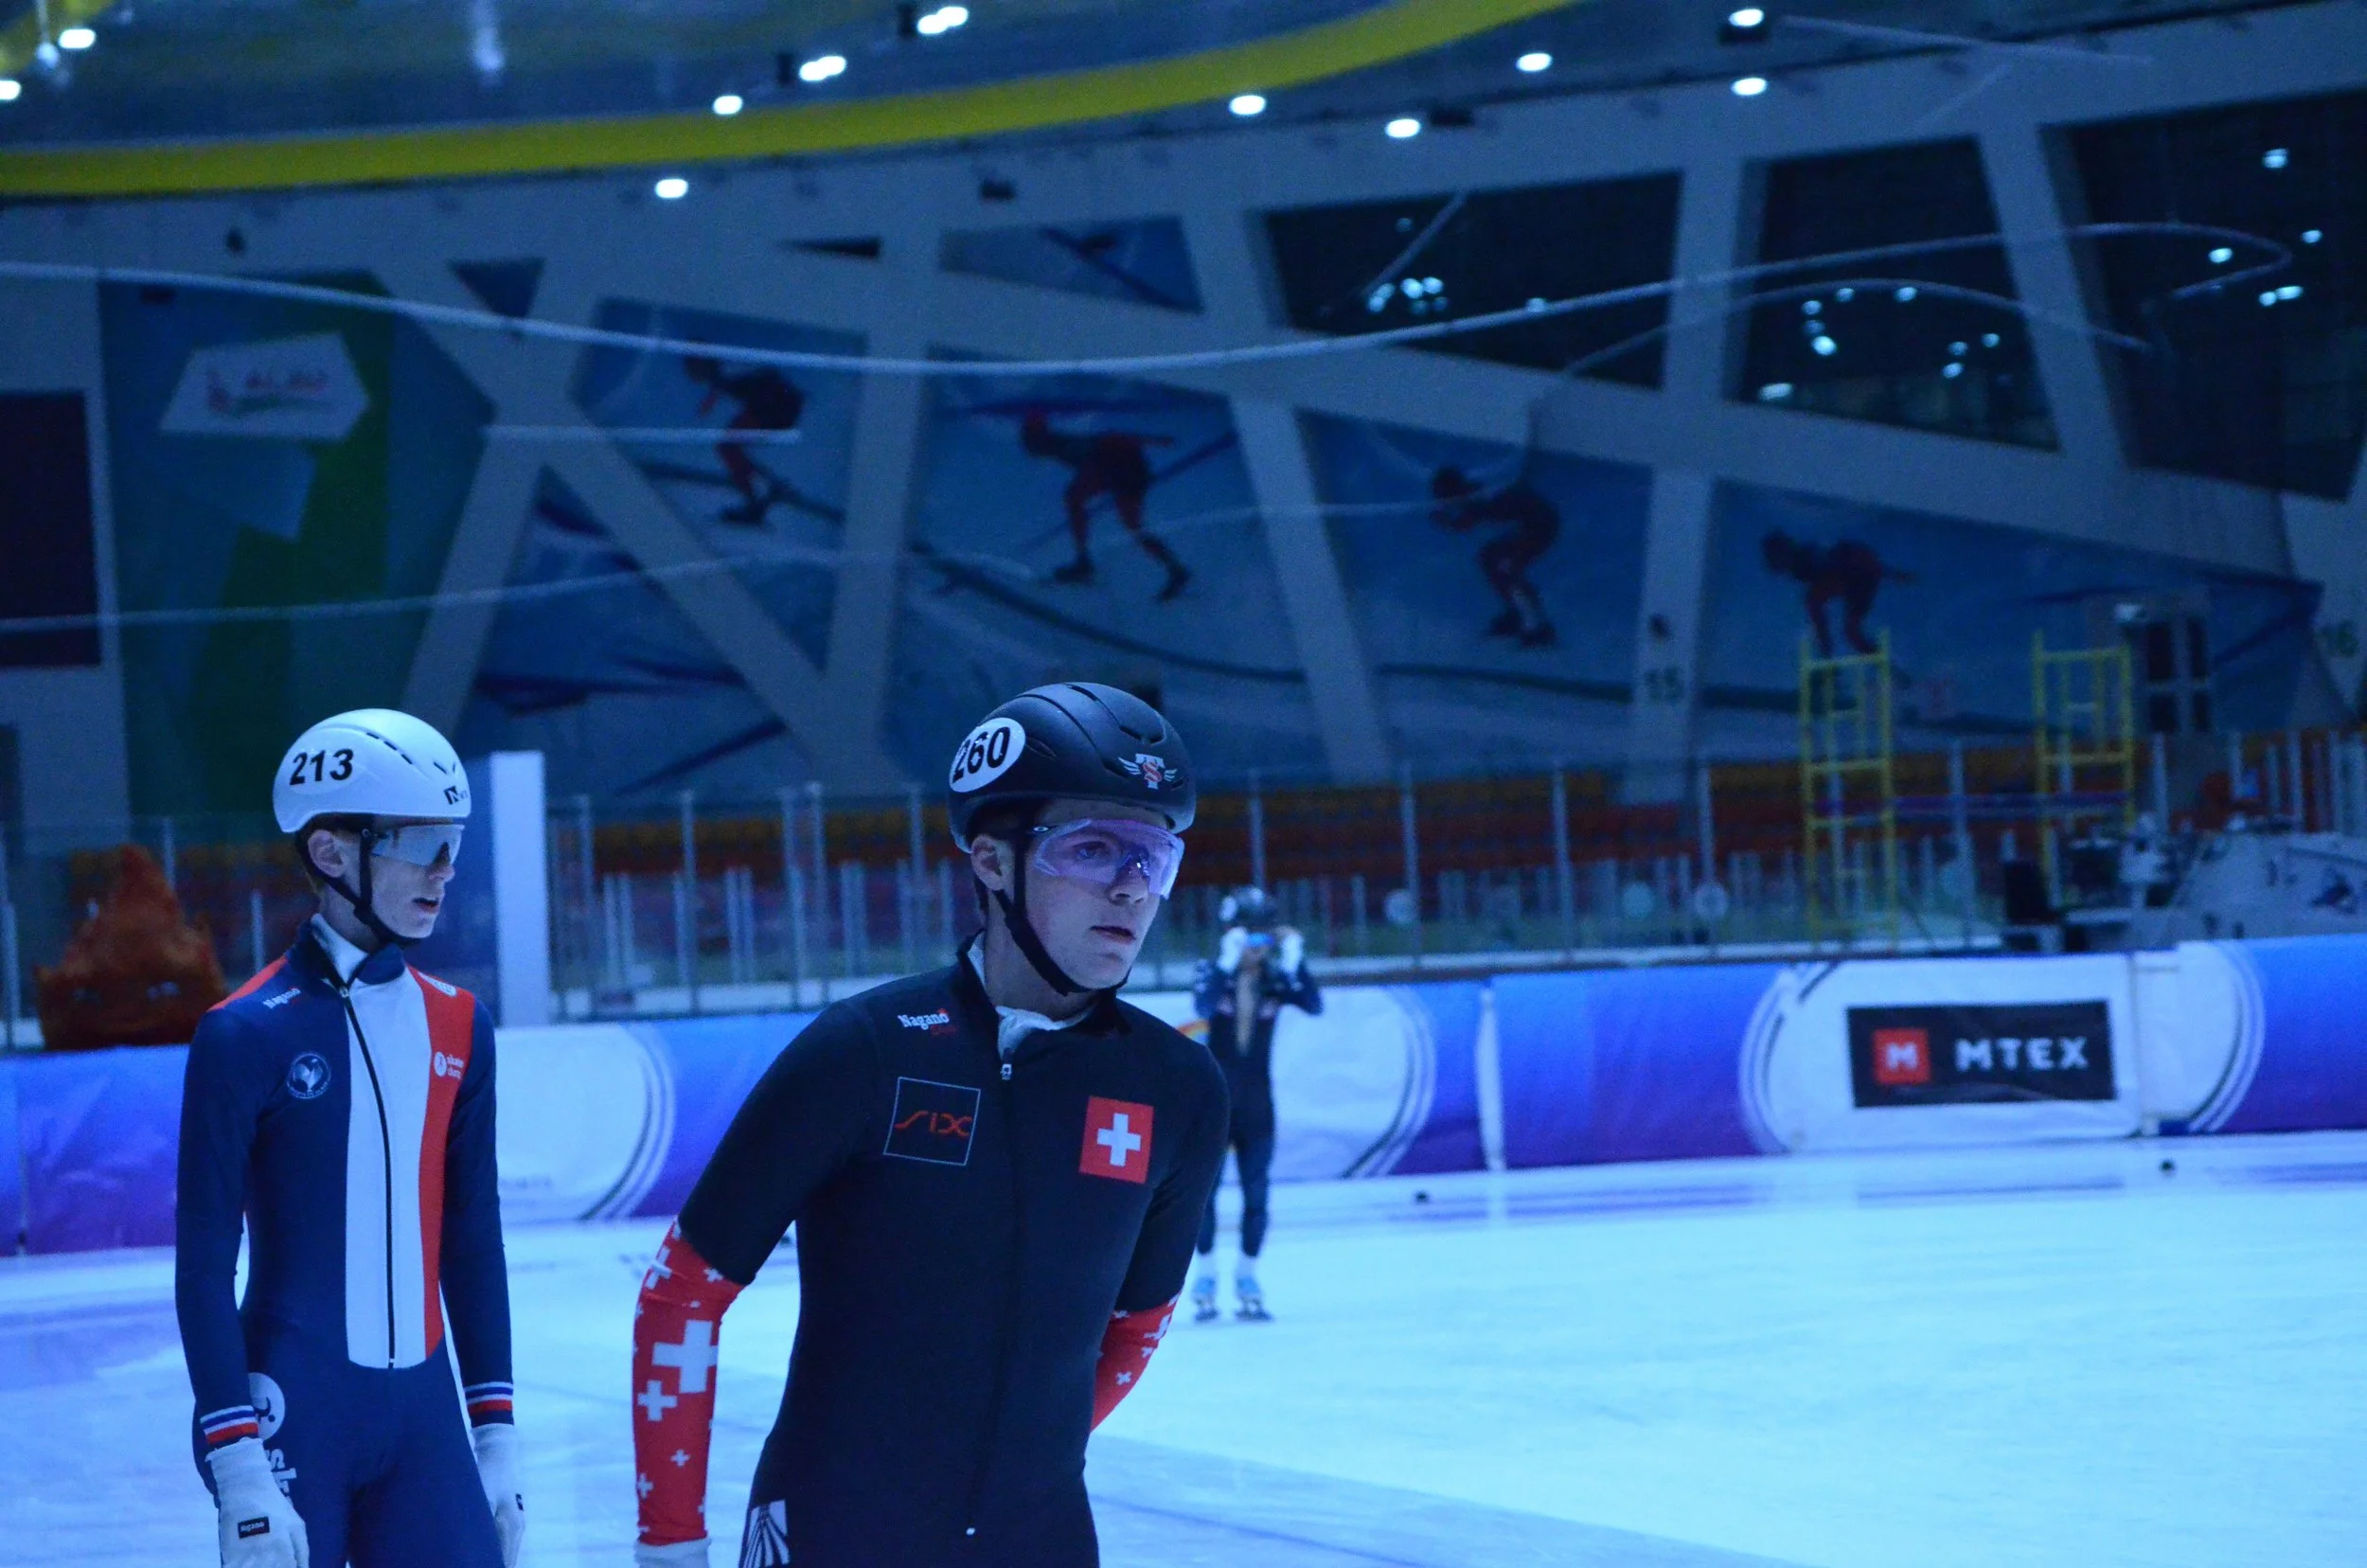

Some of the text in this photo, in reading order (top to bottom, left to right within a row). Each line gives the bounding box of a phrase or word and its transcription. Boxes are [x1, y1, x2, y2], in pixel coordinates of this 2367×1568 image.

[289, 748, 354, 786] 213
[952, 725, 1010, 783] 260
[897, 1012, 950, 1030] Nagano
[1953, 1036, 2091, 1073] MTEX
